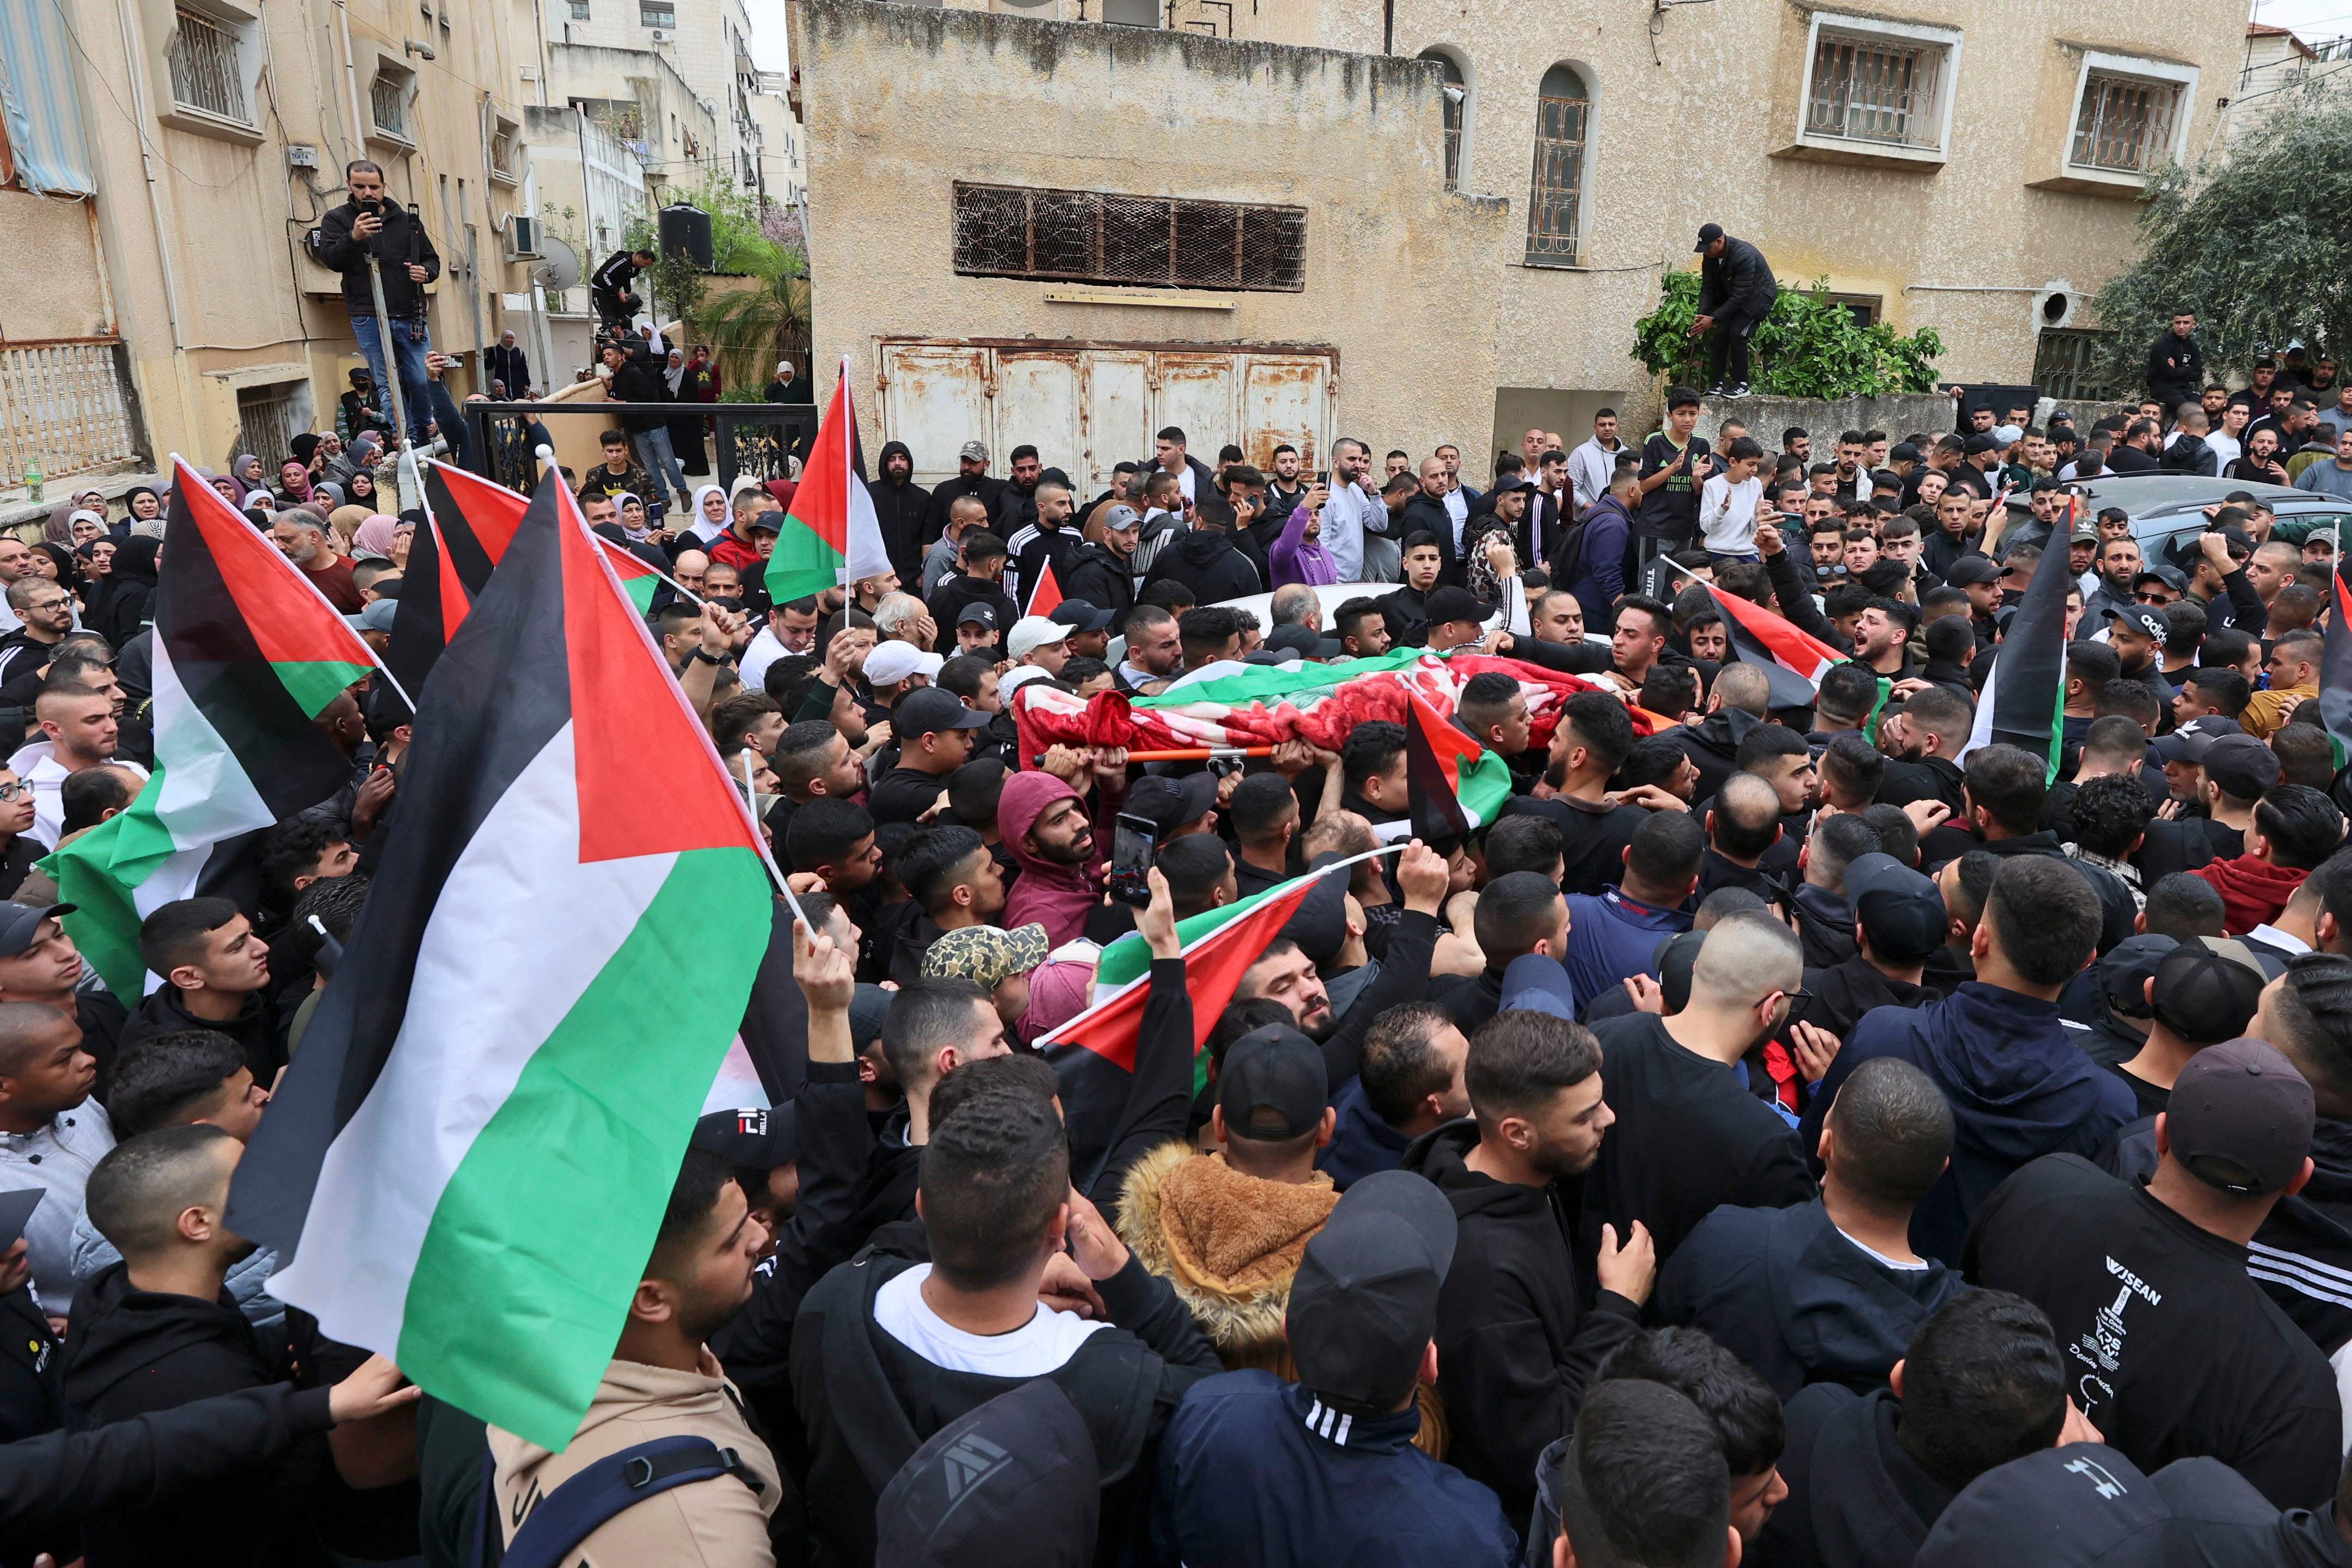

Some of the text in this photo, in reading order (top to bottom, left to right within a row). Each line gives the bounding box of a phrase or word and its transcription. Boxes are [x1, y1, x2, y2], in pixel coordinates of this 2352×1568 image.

[1675, 484, 1692, 492] BETTE
[2106, 1255, 2162, 1307] WJSEAN
[2069, 1343, 2098, 1369] Denim
